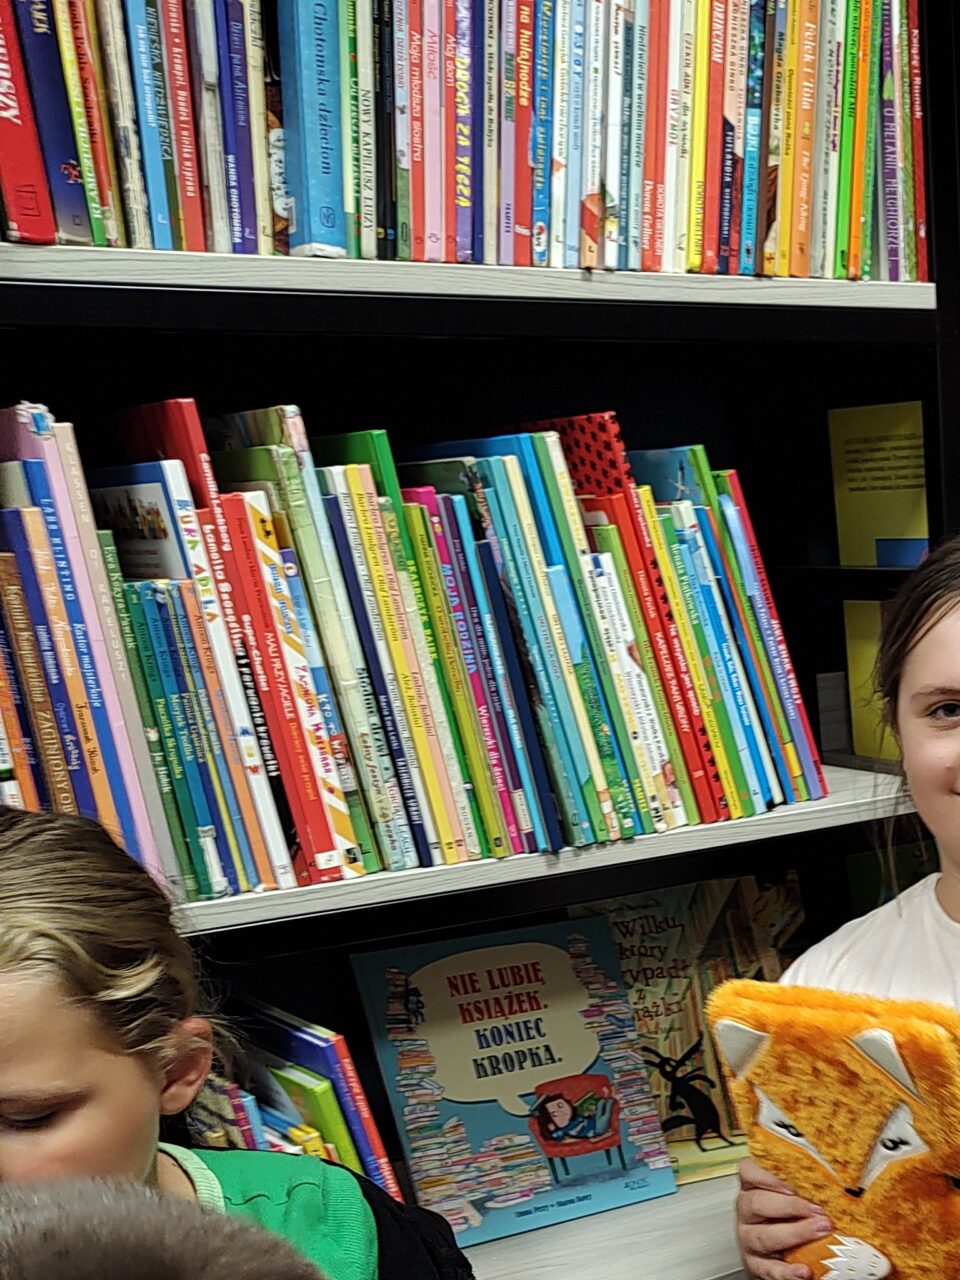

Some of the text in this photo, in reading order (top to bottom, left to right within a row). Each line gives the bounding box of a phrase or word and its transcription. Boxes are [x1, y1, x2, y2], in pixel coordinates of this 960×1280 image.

[427, 29, 438, 79] Miłość
[711, 1, 723, 64] DZIECIOM
[803, 22, 816, 62] Felek
[446, 34, 456, 86] Mój dom
[518, 29, 532, 106] hulajnodze
[773, 31, 784, 130] Magda Grabowska
[313, 2, 333, 175] Chotomska dzieciom
[410, 31, 423, 161] Moja młodsza siostra
[802, 79, 814, 110] Tola
[361, 89, 373, 231] NOWY KAPELUSZ LUIZY
[724, 132, 734, 181] TUTLANDIA
[104, 546, 118, 570] Ewa
[180, 499, 219, 624] KURA ADELA
[72, 623, 88, 653] Kastor
[82, 654, 102, 708] majsterkuje
[441, 564, 505, 792] MOJA RODZINA Wierszyki dla dzieci
[385, 717, 394, 730] Ewa
[612, 916, 685, 941] Wilku,
[617, 942, 670, 962] który
[446, 961, 546, 998] NIE LUBIĘ
[623, 960, 692, 990] ypadł
[457, 989, 549, 1025] KSIĄŻEK.
[633, 992, 687, 1023] iążki
[474, 1017, 547, 1050] KONIEC
[471, 1044, 563, 1079] KROPKA.
